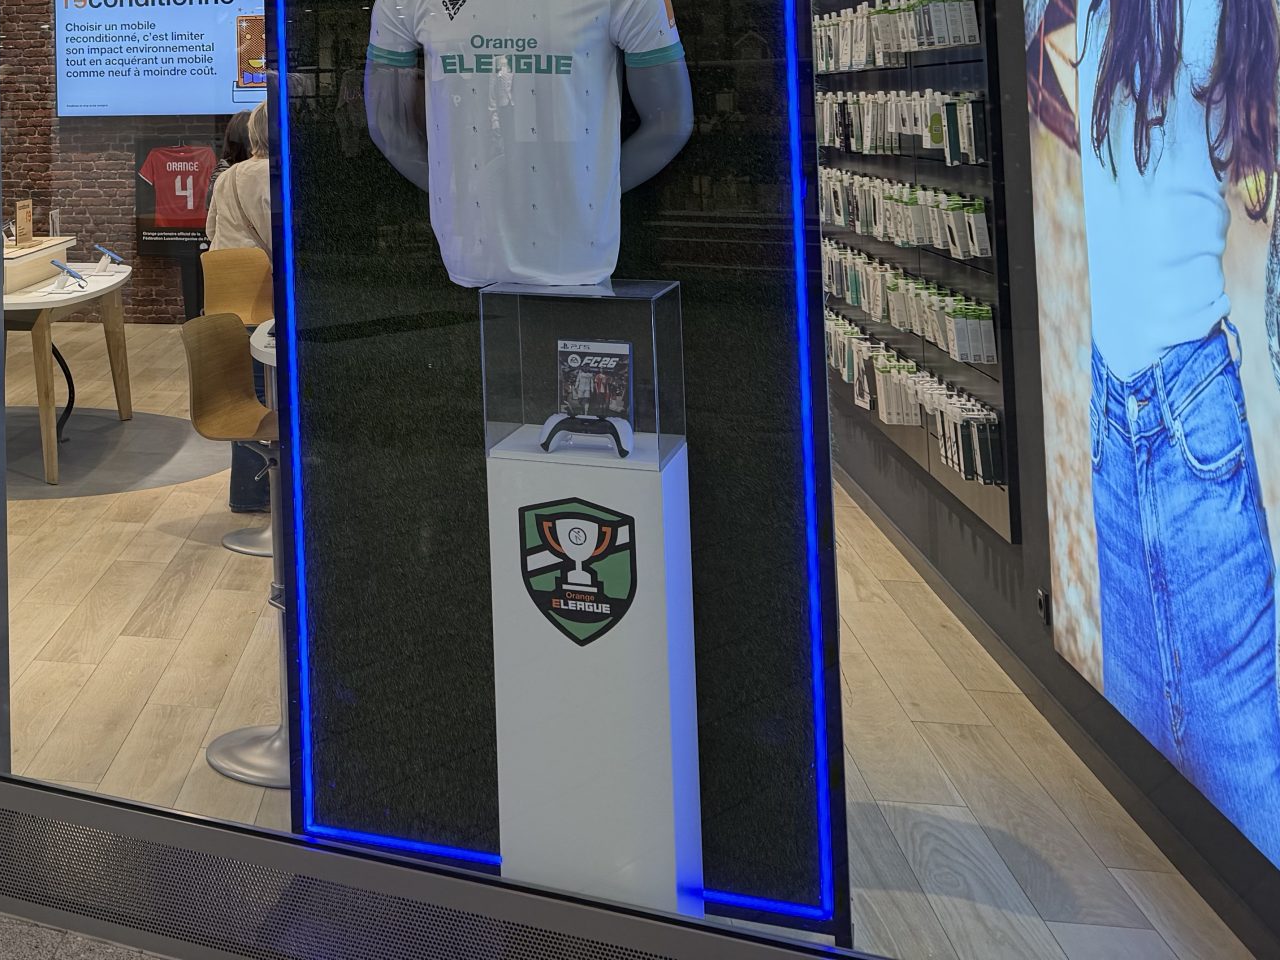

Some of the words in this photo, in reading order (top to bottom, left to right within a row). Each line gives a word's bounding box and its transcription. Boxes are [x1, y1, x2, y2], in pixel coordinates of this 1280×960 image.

[65, 22, 102, 32] Choisir
[104, 23, 118, 31] un
[120, 21, 156, 31] mobile
[65, 33, 140, 44] reconditionné,
[171, 31, 205, 41] limiter
[470, 34, 538, 52] Orange
[65, 47, 85, 55] son
[87, 44, 123, 56] impact
[125, 42, 215, 54] environnemental
[65, 57, 87, 67] tout
[89, 58, 102, 66] en
[104, 55, 158, 68] acquérant
[161, 56, 174, 64] un
[177, 54, 213, 64] mobile
[66, 69, 105, 78] comme
[108, 67, 131, 77] neuf
[133, 66, 140, 76] à
[143, 66, 187, 76] moindre
[189, 65, 217, 76] coût.
[166, 161, 200, 172] ORANGE
[174, 175, 194, 210] 4
[565, 591, 595, 602] Orange
[551, 598, 611, 614] ELEAGUE
